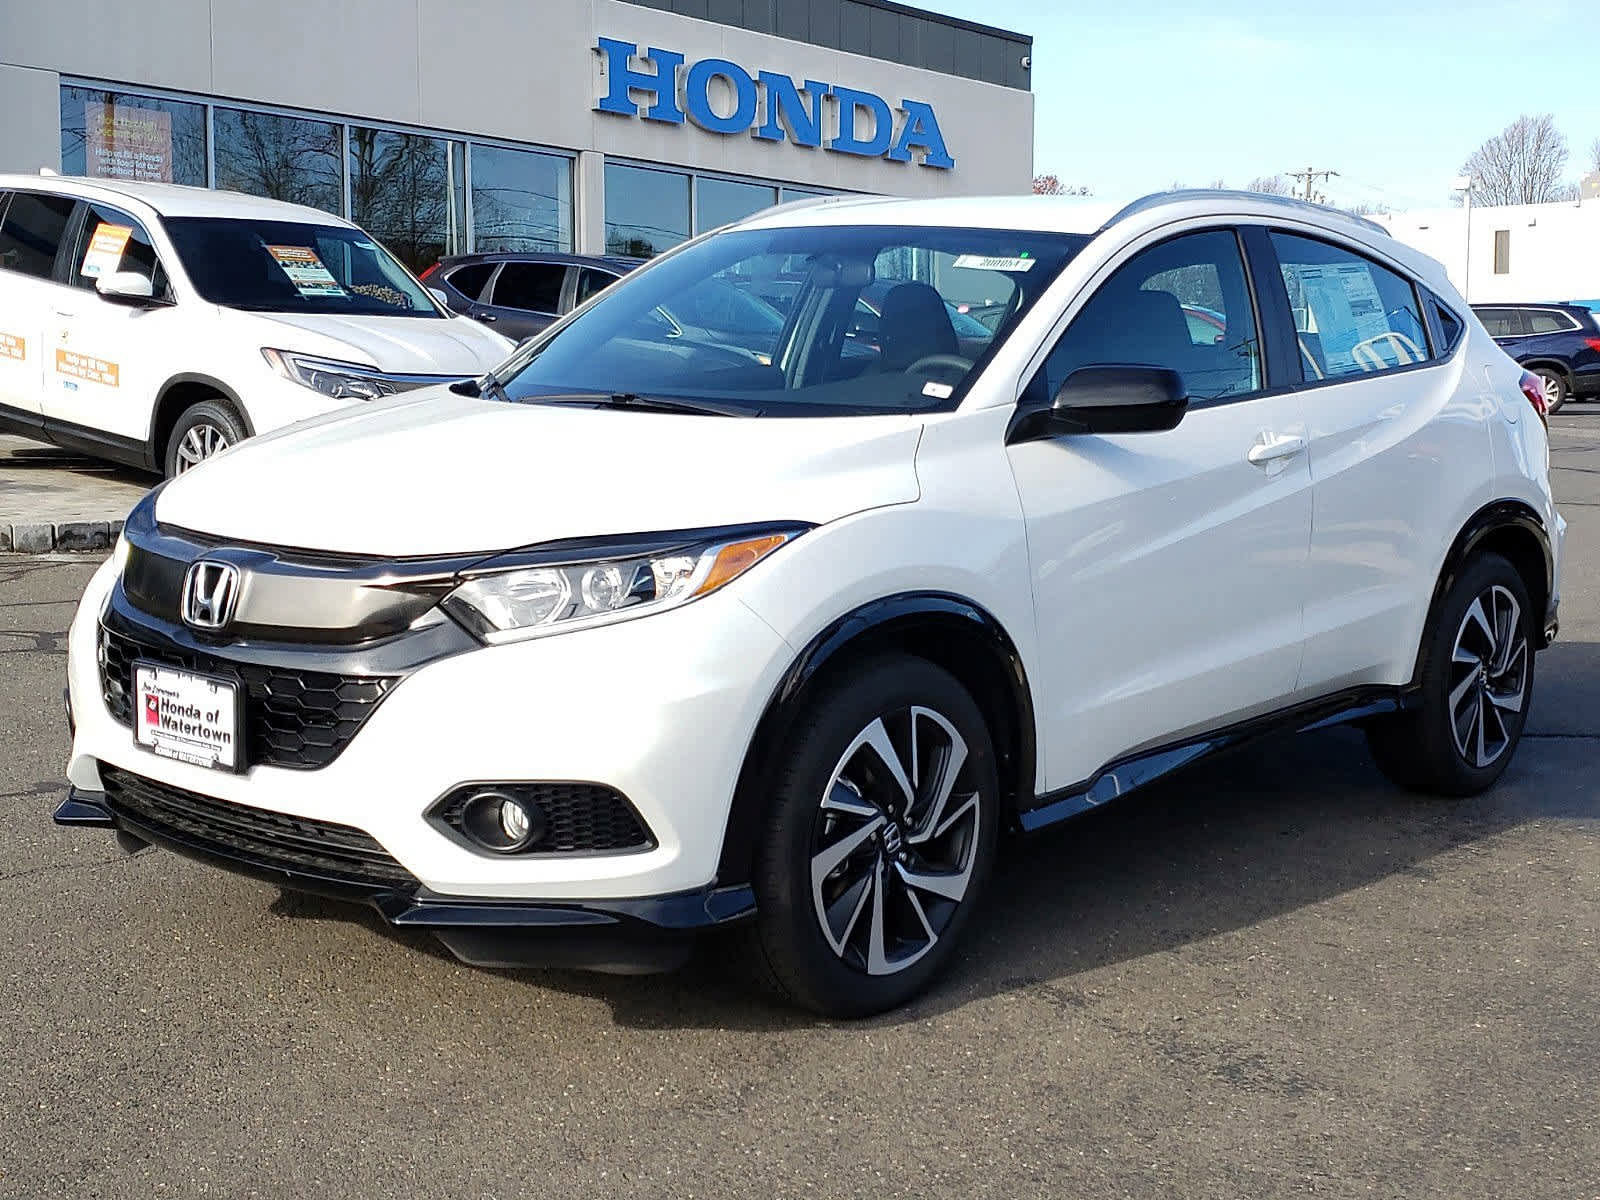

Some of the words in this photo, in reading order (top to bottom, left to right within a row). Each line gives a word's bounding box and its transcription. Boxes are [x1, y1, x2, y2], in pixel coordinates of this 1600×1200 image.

[597, 37, 955, 169] HONDA
[161, 698, 201, 719] Honda
[206, 709, 219, 724] of
[161, 713, 231, 745] Watertown
